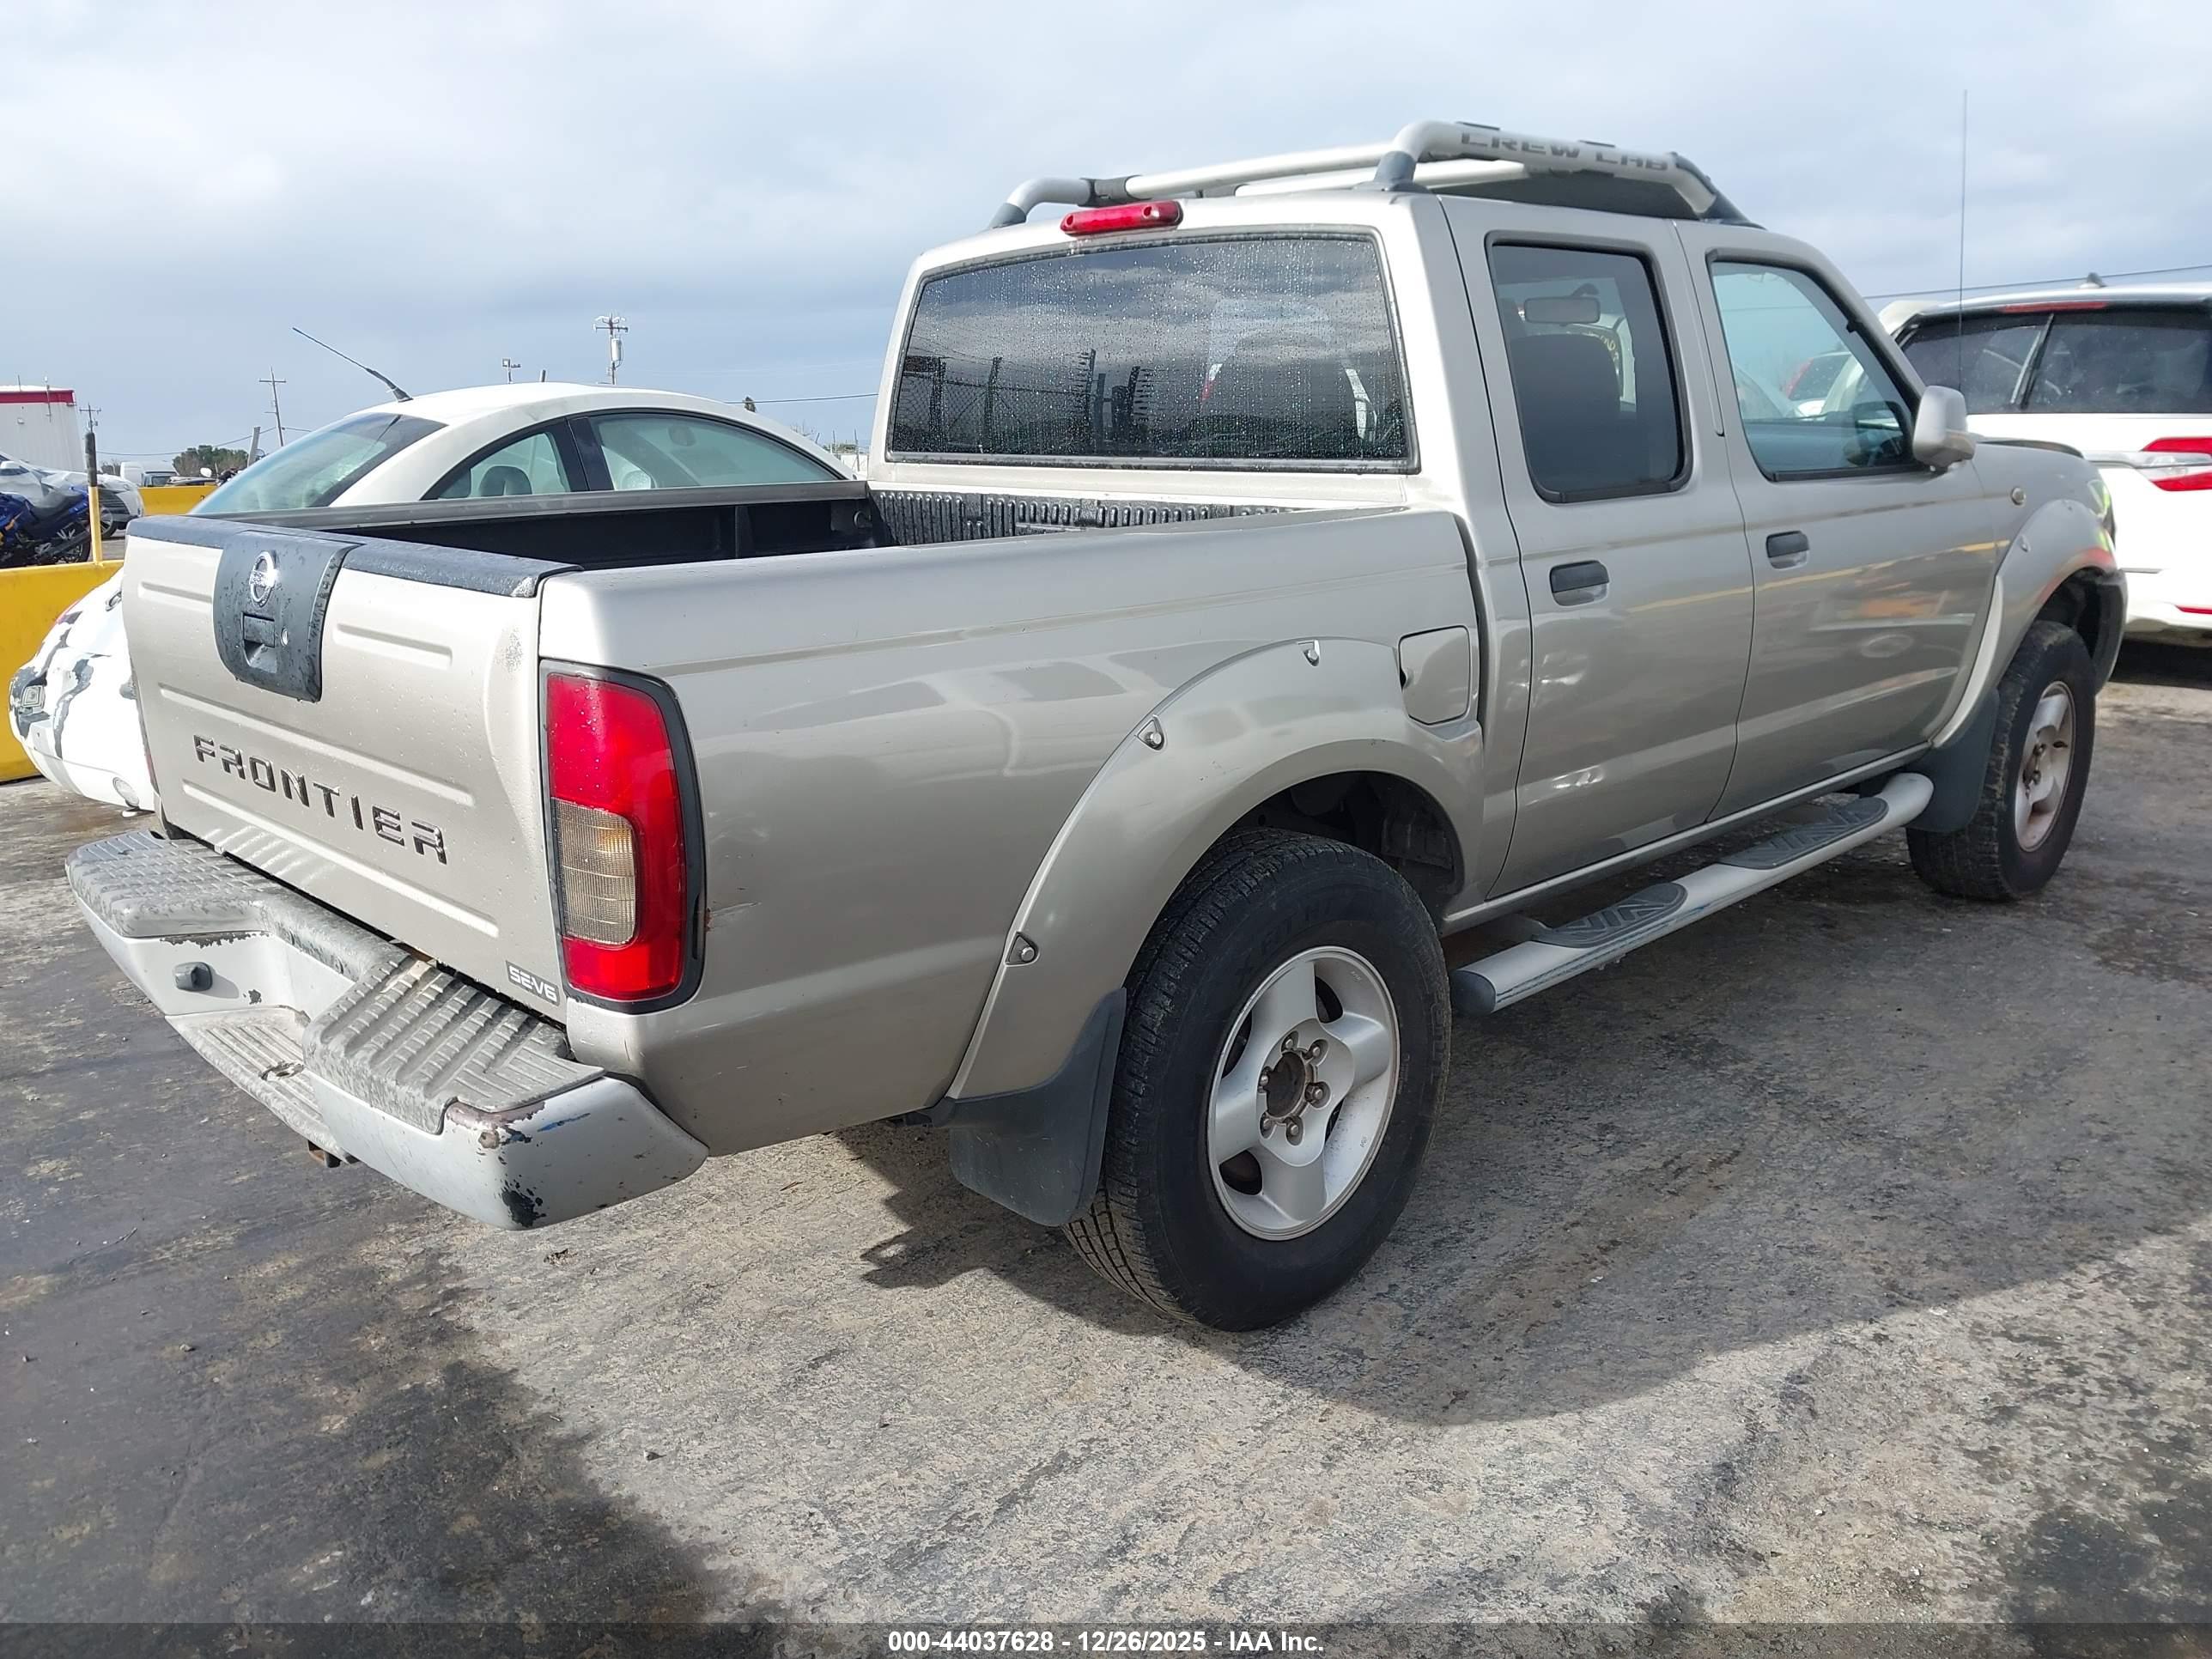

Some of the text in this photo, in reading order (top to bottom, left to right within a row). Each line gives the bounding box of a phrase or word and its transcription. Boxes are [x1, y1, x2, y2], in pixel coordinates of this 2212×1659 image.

[1461, 131, 1668, 171] CREW CAB
[193, 734, 447, 866] FRONTIER
